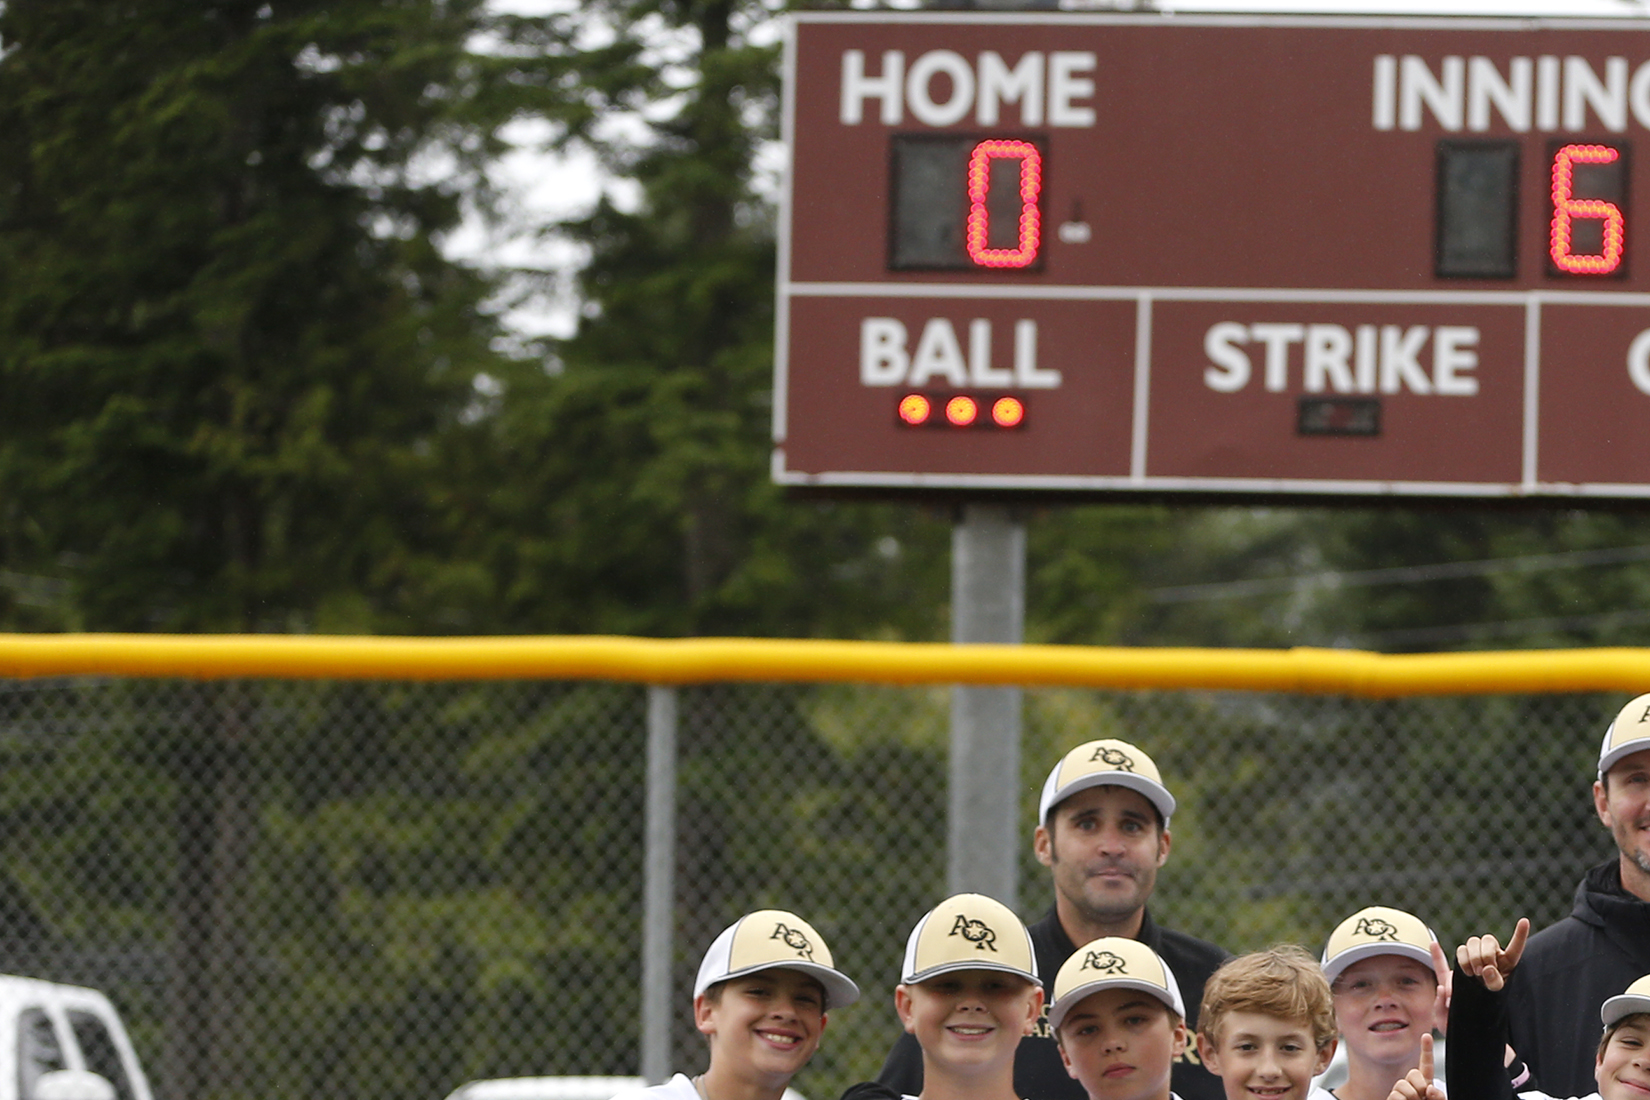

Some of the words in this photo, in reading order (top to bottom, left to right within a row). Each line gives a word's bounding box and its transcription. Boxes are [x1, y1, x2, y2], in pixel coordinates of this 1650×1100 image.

[840, 49, 1097, 128] HOME
[967, 139, 1041, 268] 0
[1550, 144, 1624, 275] 6
[859, 317, 1062, 389] BALL
[1204, 322, 1480, 395] STRIKE
